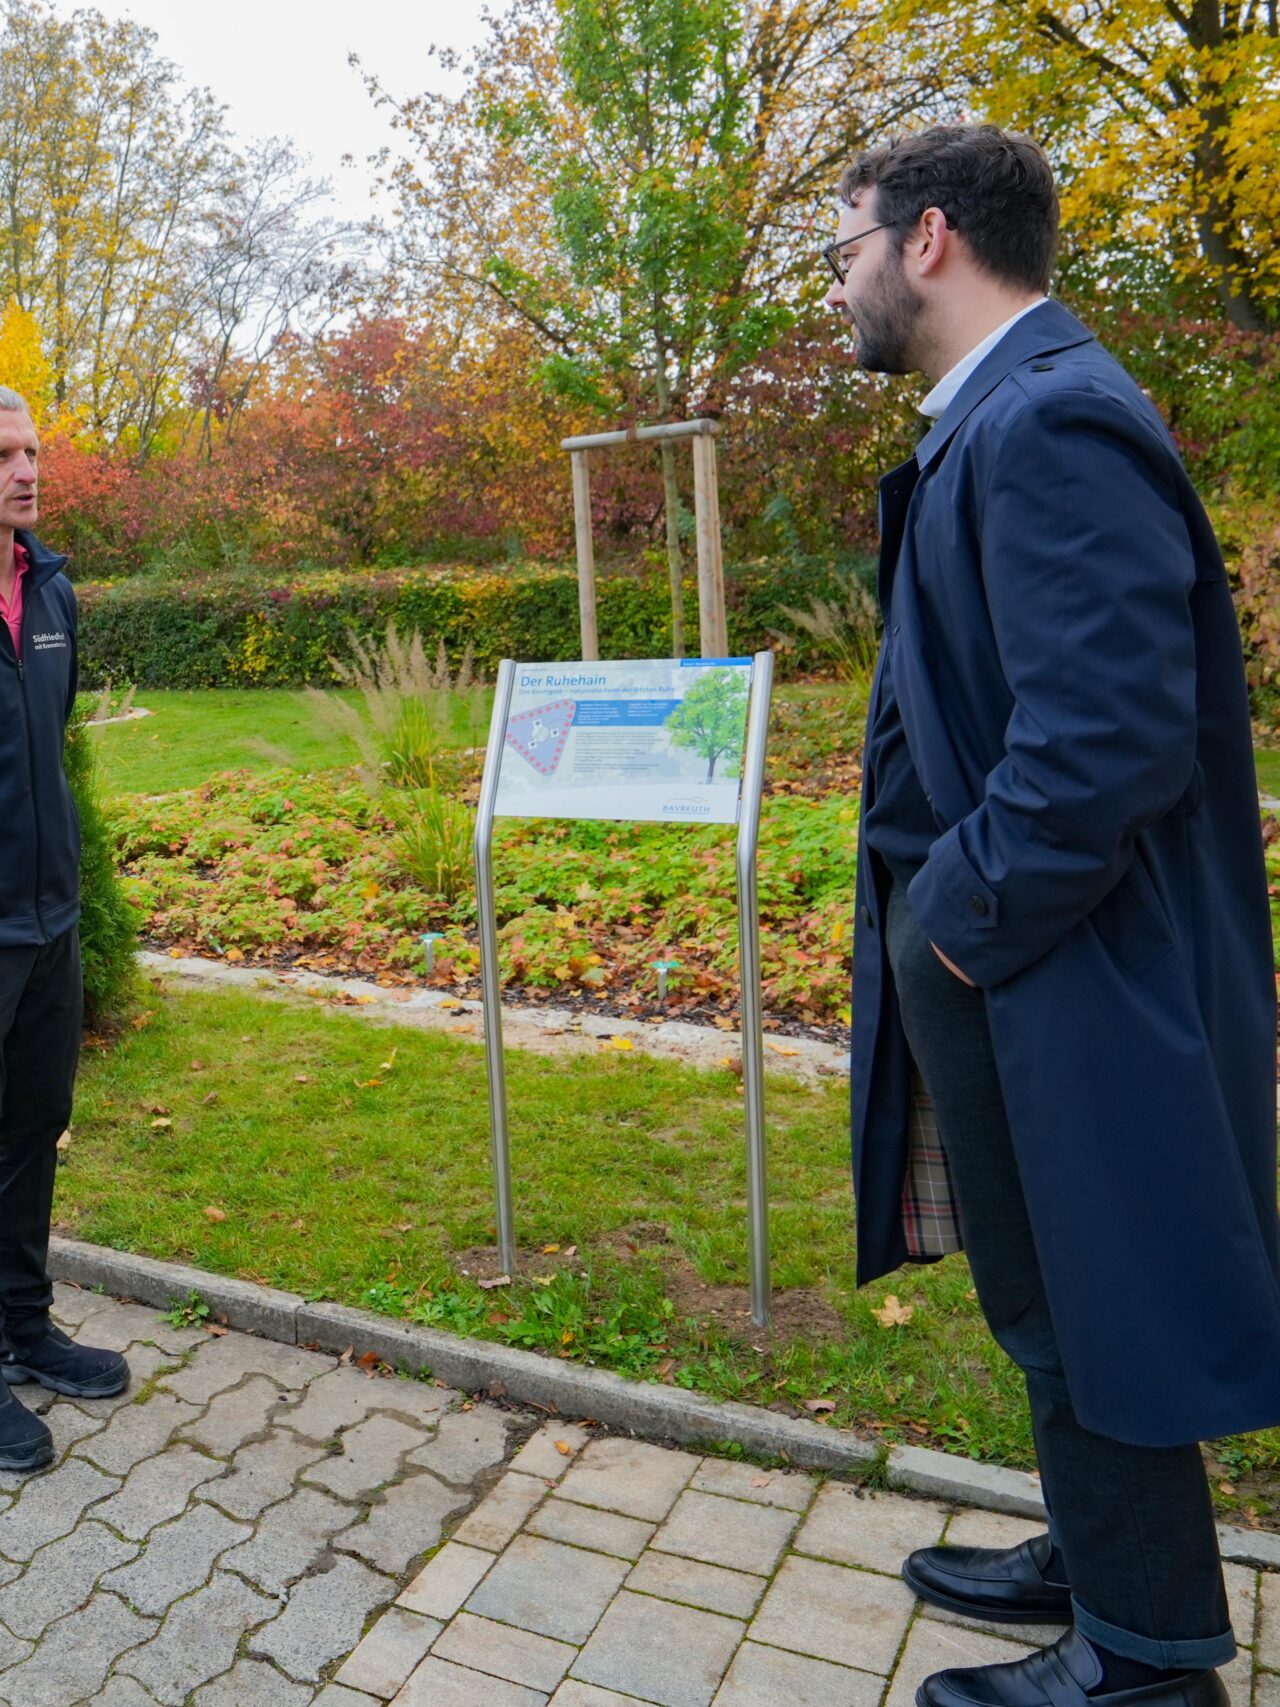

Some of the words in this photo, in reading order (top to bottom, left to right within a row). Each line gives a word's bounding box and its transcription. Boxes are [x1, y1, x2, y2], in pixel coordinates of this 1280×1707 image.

[521, 676, 543, 687] Der
[546, 674, 606, 686] Ruhehain
[663, 805, 711, 813] BAYREUTH
